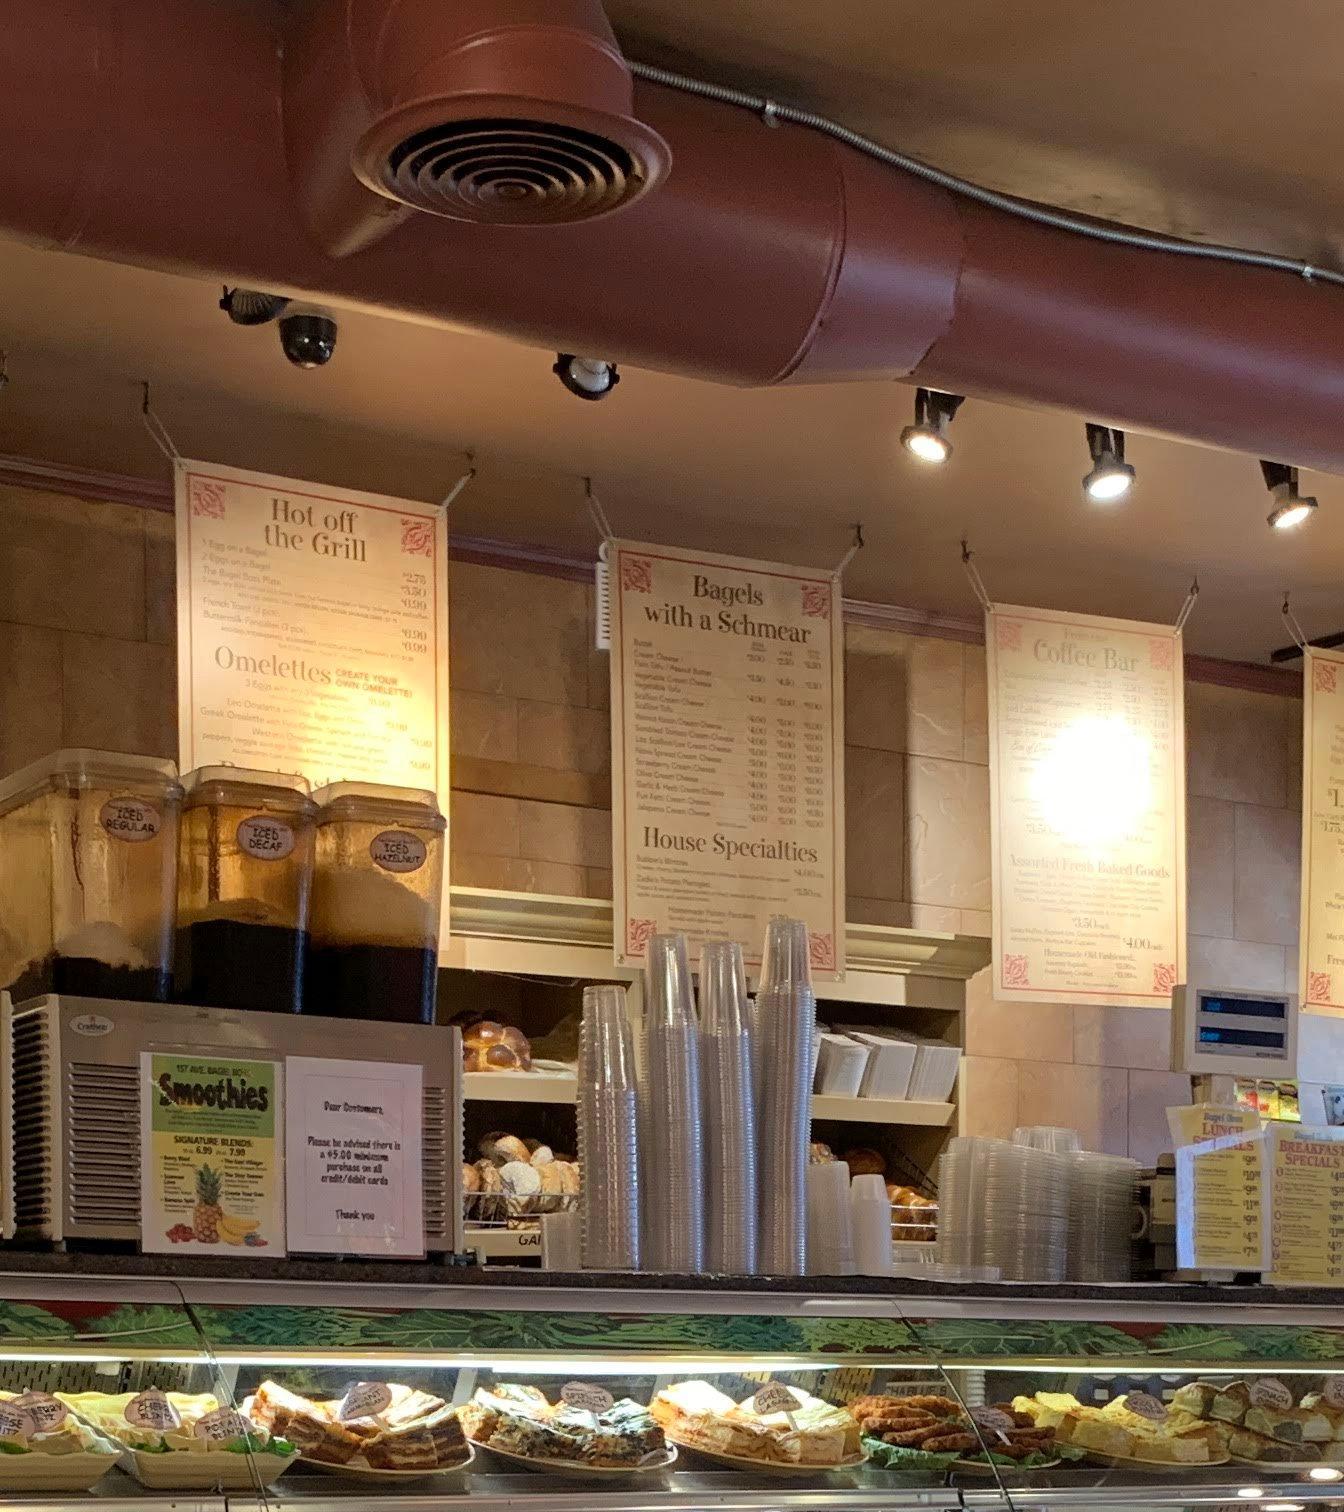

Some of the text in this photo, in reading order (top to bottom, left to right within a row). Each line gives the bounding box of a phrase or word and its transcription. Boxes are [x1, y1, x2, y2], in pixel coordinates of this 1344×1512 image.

[270, 497, 359, 533] Hot off
[264, 524, 367, 562] the Grill
[692, 574, 764, 608] Bagels
[644, 603, 812, 645] with a Schmear
[1032, 637, 1139, 673] Coffee Bar
[214, 645, 333, 686] Omelettes
[115, 809, 144, 822] ICED
[105, 818, 154, 833] REGULAR
[252, 828, 280, 842] ICED
[247, 838, 284, 851] DECAF
[384, 842, 409, 855] ICED
[643, 825, 819, 864] House Specialties
[373, 851, 422, 865] HAZELNUT
[159, 1072, 268, 1112] Smoothies
[1202, 1123, 1244, 1135] LUNCH
[174, 1136, 218, 1145] SIGNATURE
[307, 1136, 330, 1147] Please
[333, 1139, 341, 1148] be
[327, 1161, 383, 1174] purchase on all
[1284, 1153, 1341, 1168] SPECIALS
[367, 1176, 389, 1186] cards
[335, 1209, 375, 1221] Thank you
